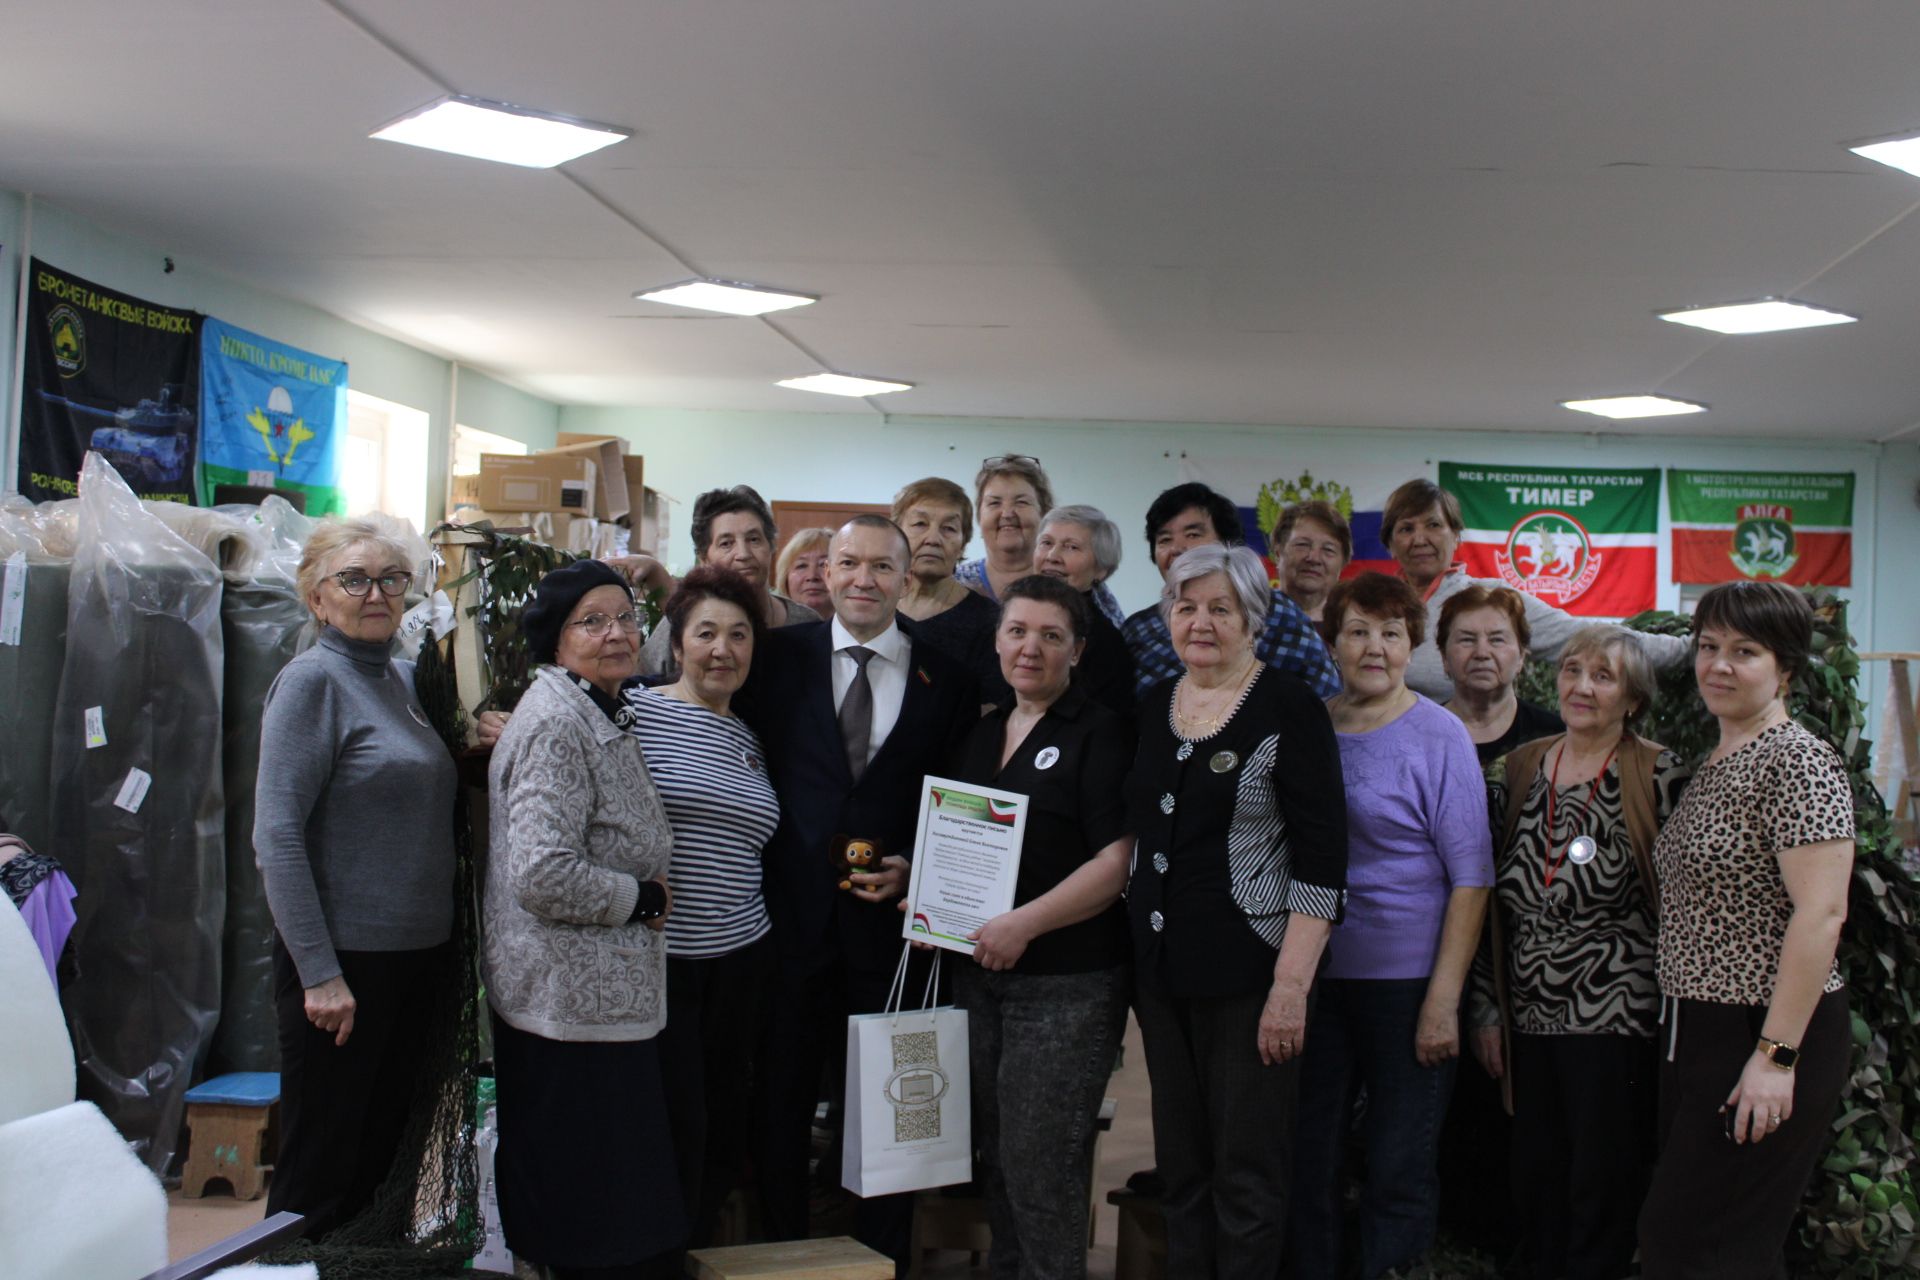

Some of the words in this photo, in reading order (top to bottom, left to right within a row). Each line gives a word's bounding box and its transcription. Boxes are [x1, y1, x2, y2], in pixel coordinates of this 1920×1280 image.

[147, 309, 193, 334] ВОЙСКА
[1457, 470, 1484, 481] МСБ
[1487, 472, 1568, 484] РЕСПУБЛИКА
[1570, 475, 1644, 486] ТАТАРСТАН
[1505, 486, 1595, 507] ТИМЕР
[1771, 488, 1829, 500] ТАТАРСТАН
[1743, 504, 1786, 519] АЛГА
